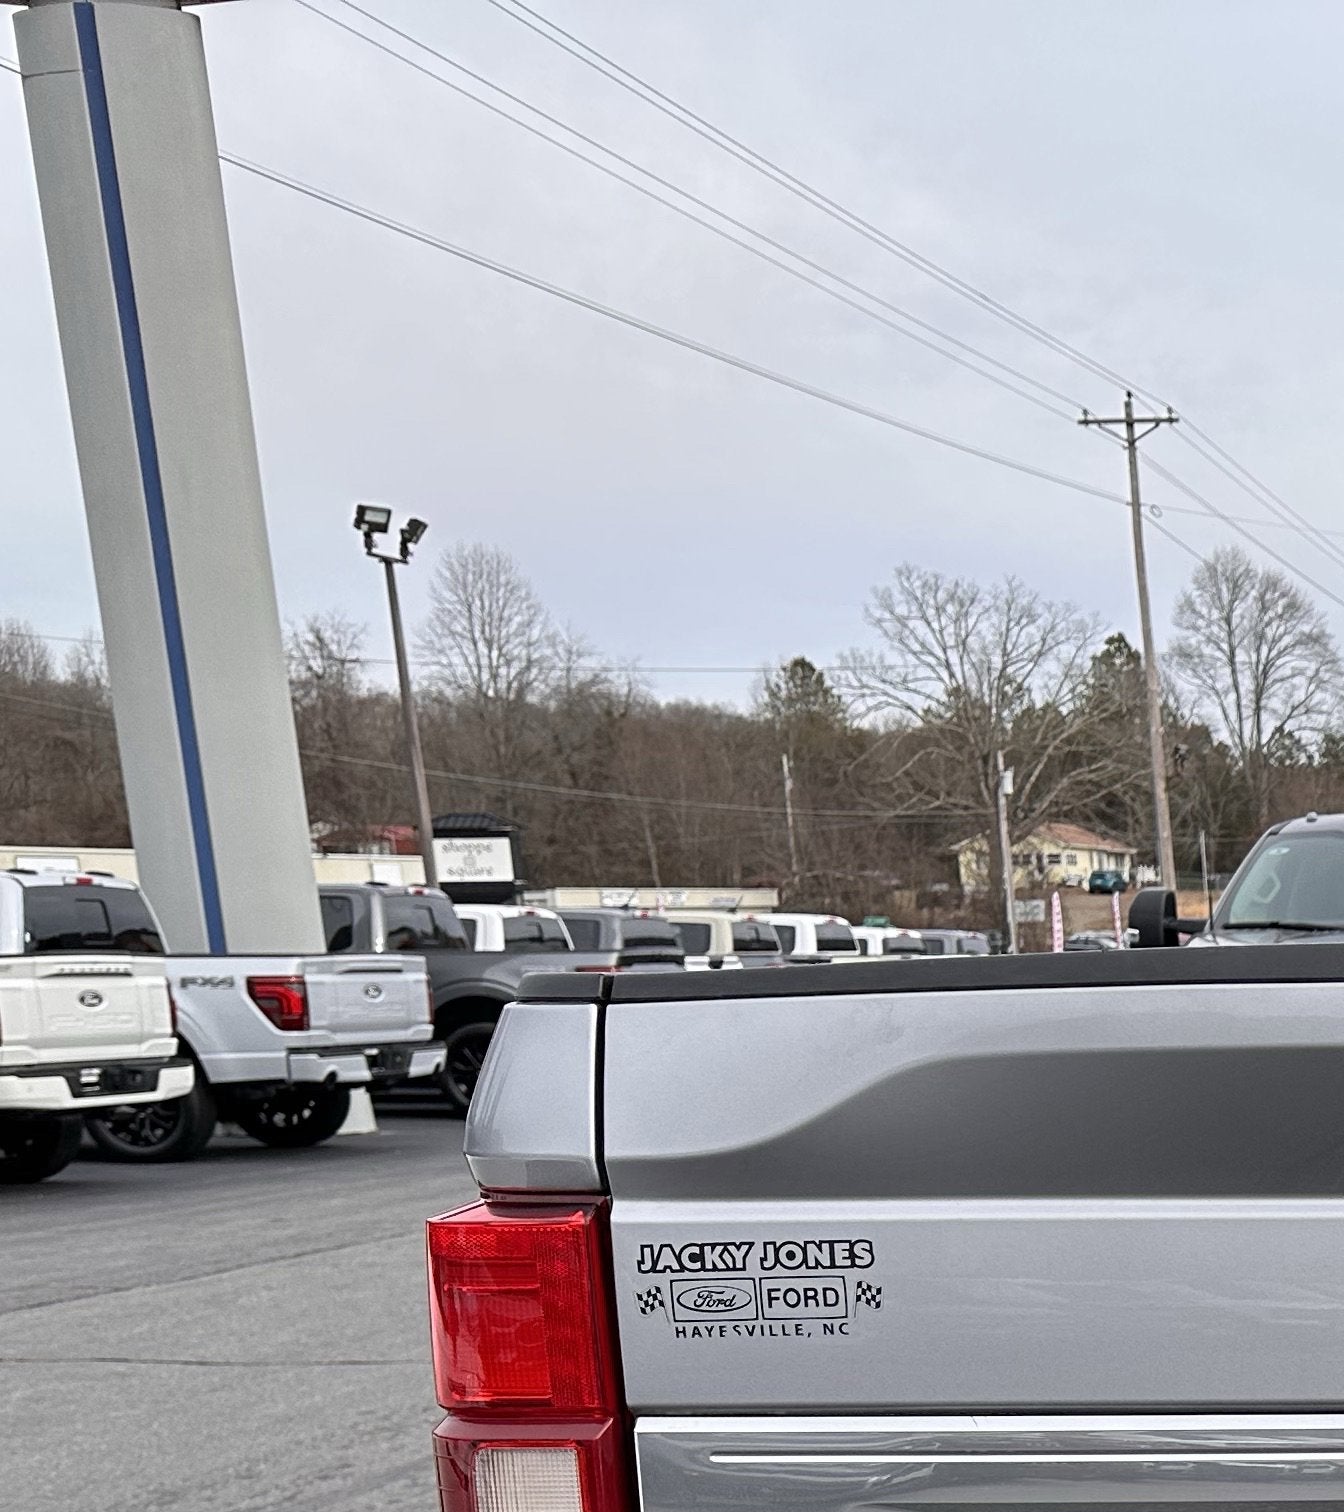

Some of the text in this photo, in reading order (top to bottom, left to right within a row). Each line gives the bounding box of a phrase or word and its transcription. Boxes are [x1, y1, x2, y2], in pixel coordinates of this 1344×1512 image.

[180, 977, 234, 988] FX4
[637, 1240, 874, 1273] JACKY JONES
[693, 1290, 736, 1308] Ford
[767, 1287, 840, 1309] FORD
[675, 1323, 849, 1338] HAYESVILLE, NC
